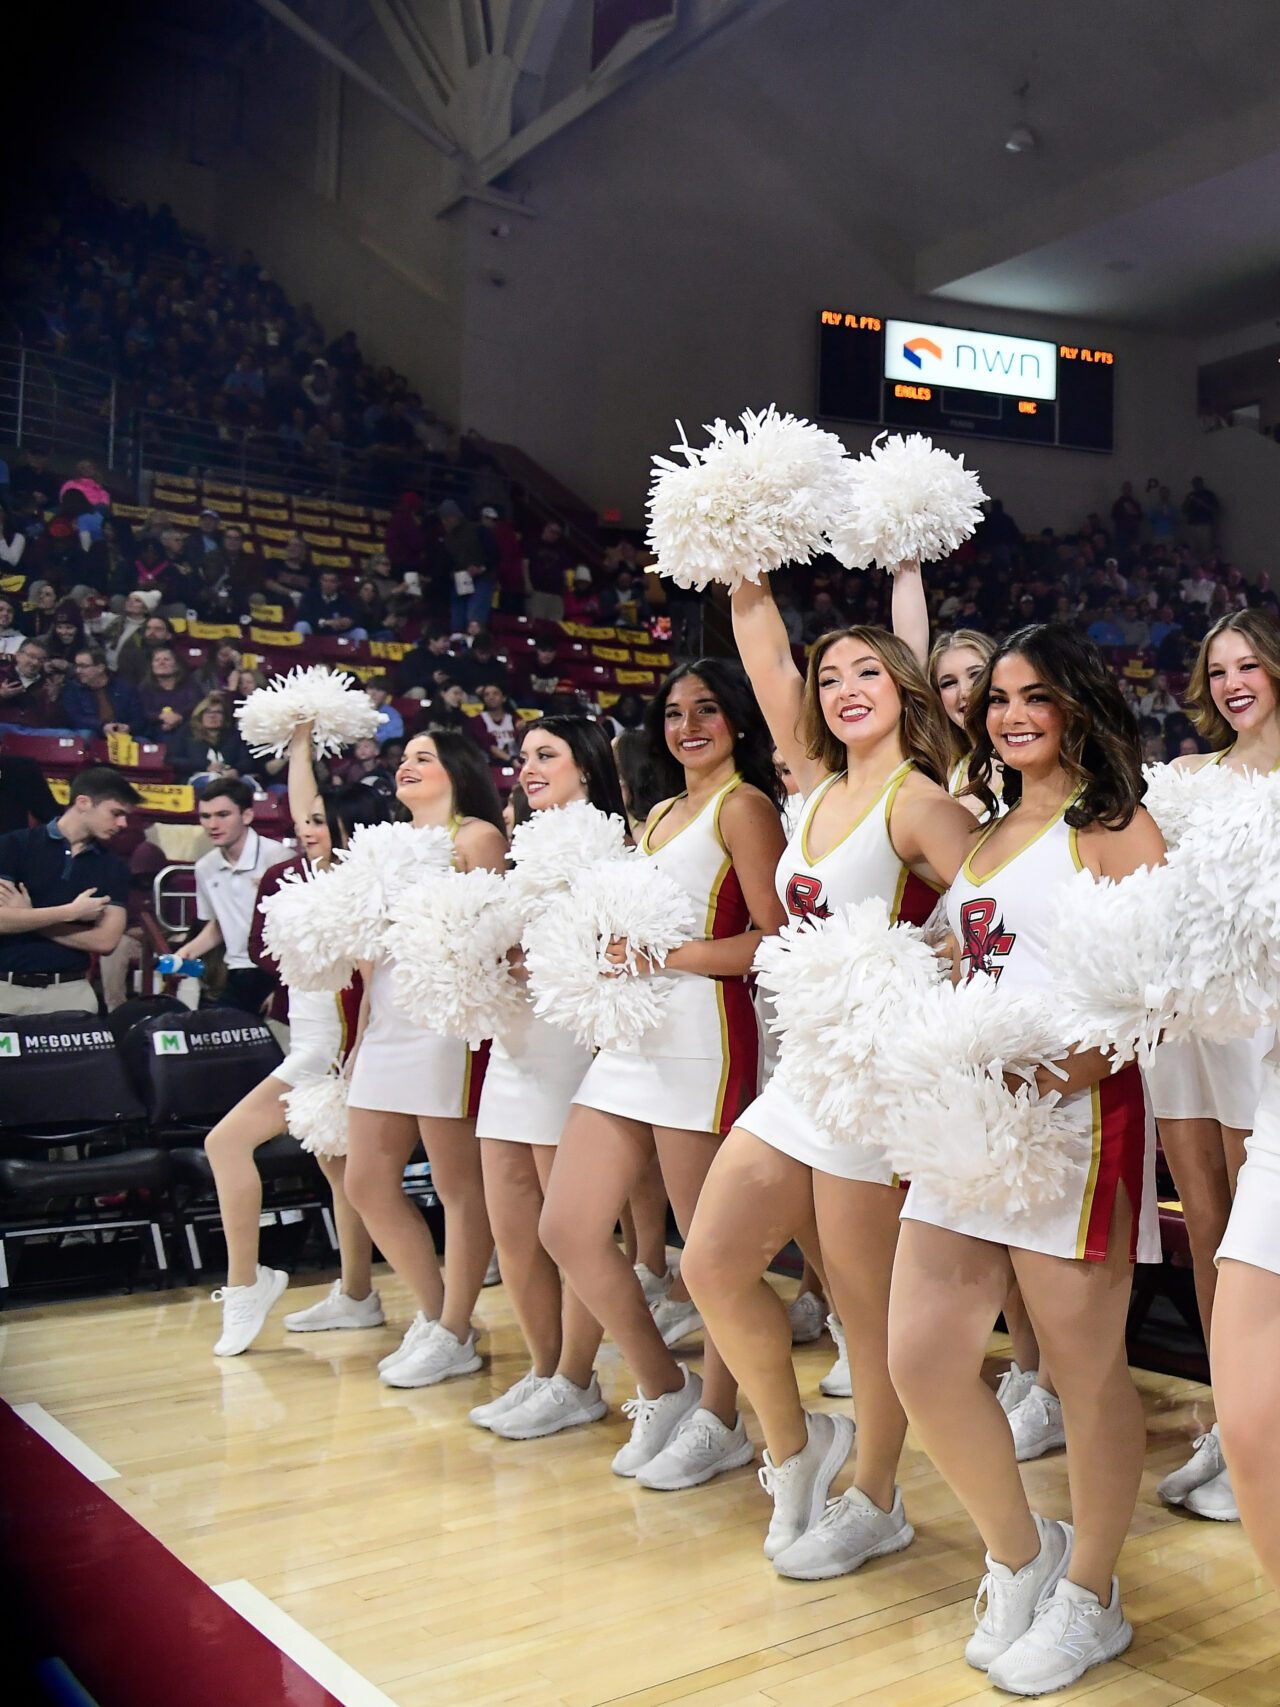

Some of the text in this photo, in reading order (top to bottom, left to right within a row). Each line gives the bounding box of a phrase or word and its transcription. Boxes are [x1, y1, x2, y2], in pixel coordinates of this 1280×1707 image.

[845, 314, 858, 328] FL
[860, 316, 880, 331] PTS
[956, 345, 1040, 379] nwn
[1081, 349, 1093, 361] FL
[1094, 351, 1113, 364] PTS
